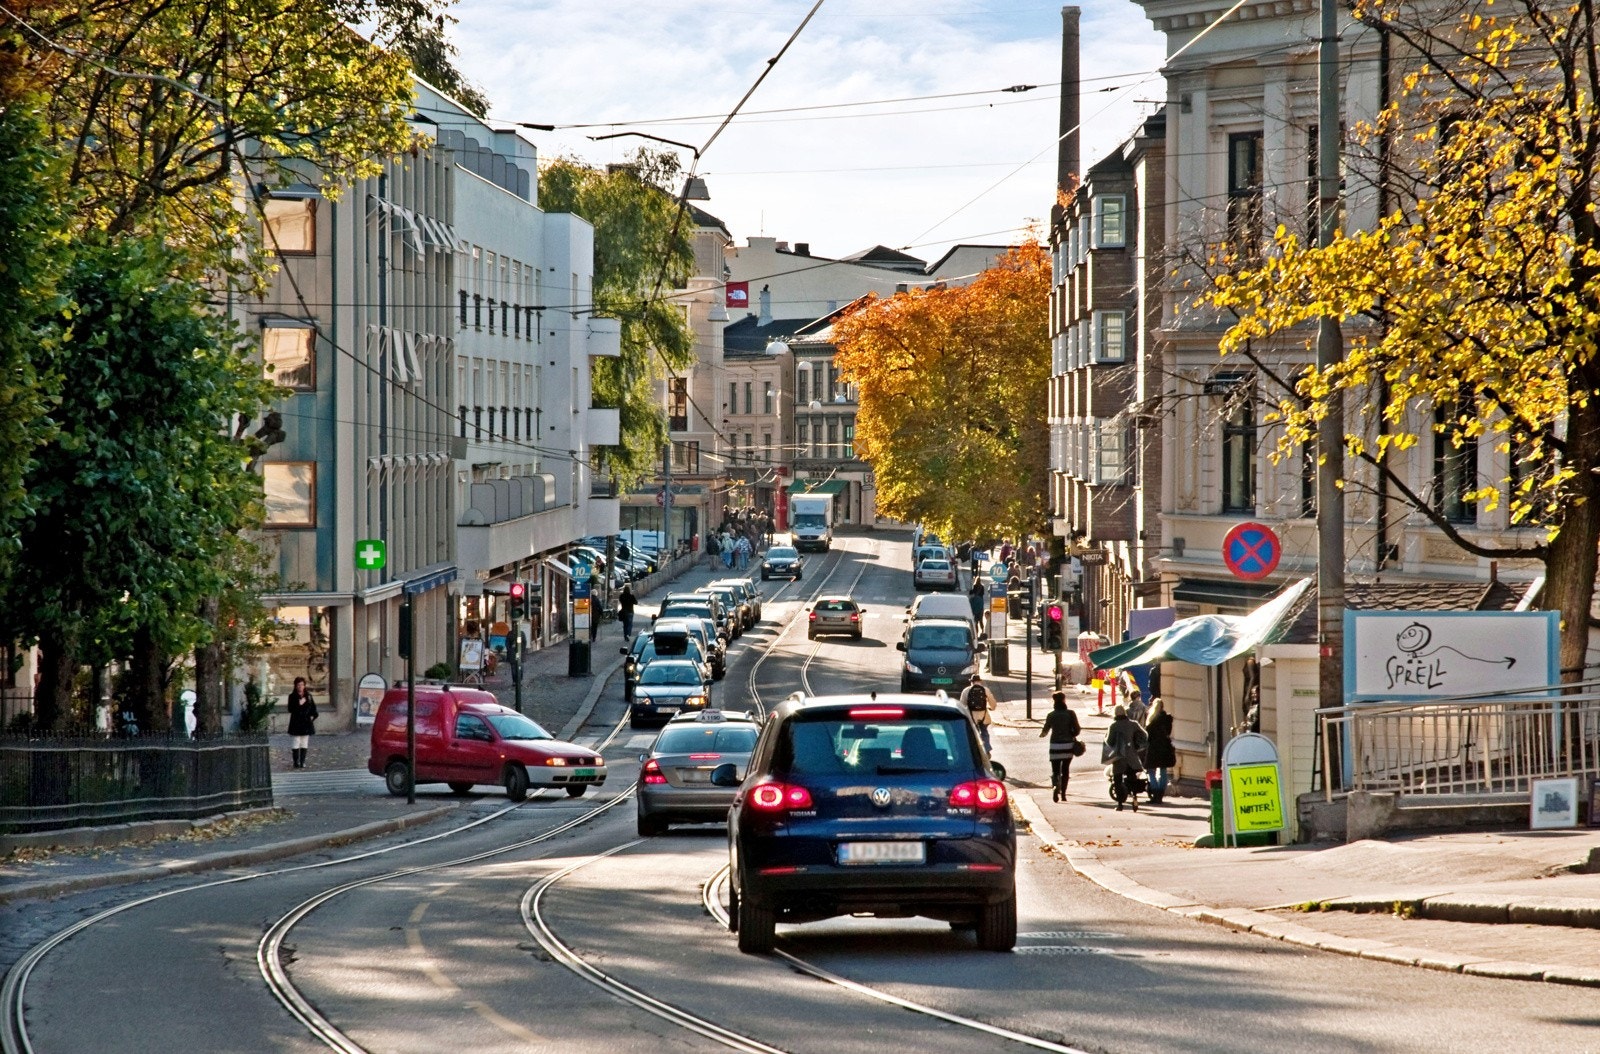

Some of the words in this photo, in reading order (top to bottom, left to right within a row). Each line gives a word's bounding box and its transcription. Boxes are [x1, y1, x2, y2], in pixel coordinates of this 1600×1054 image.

[1082, 553, 1103, 561] NIKITA
[575, 566, 586, 576] 10
[992, 566, 1003, 575] 10
[1386, 655, 1447, 690] SPRELL
[1256, 775, 1274, 785] HAR
